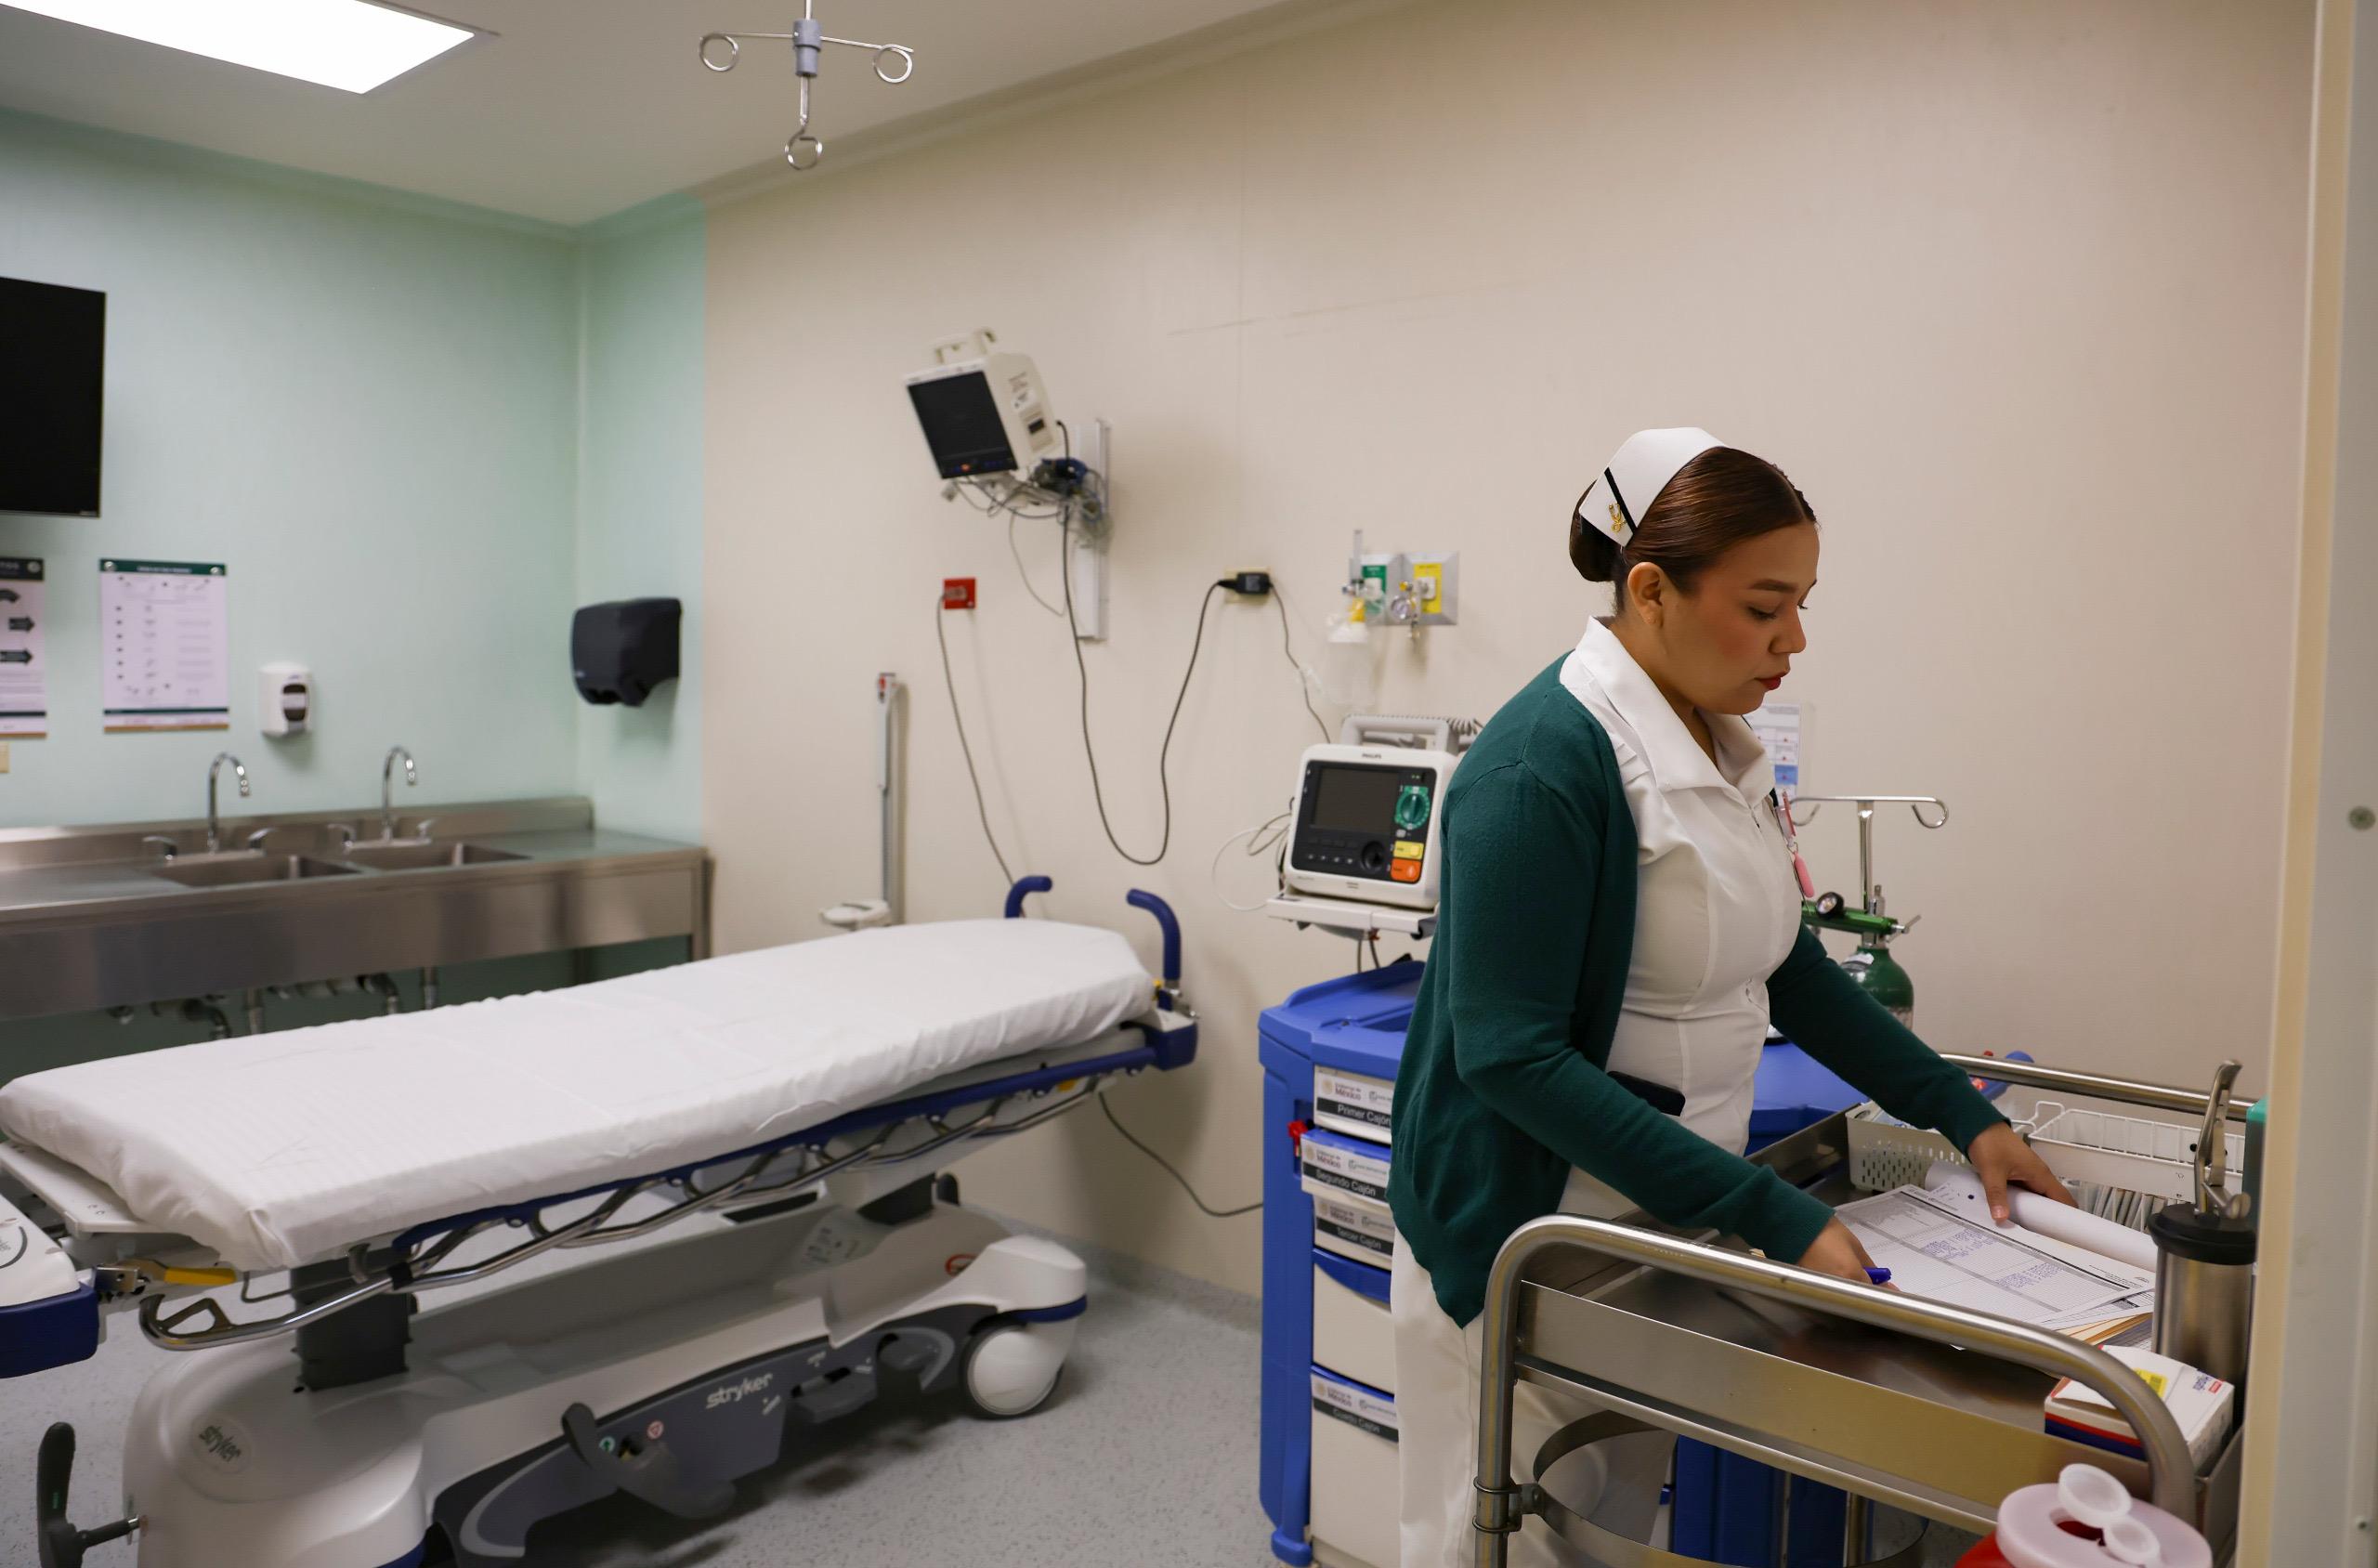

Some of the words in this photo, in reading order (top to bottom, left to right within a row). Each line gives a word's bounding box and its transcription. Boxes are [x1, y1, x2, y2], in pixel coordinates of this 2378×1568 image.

[1338, 1104, 1365, 1120] Primer
[1315, 1169, 1350, 1190] Segundo
[706, 1373, 773, 1409] stryker
